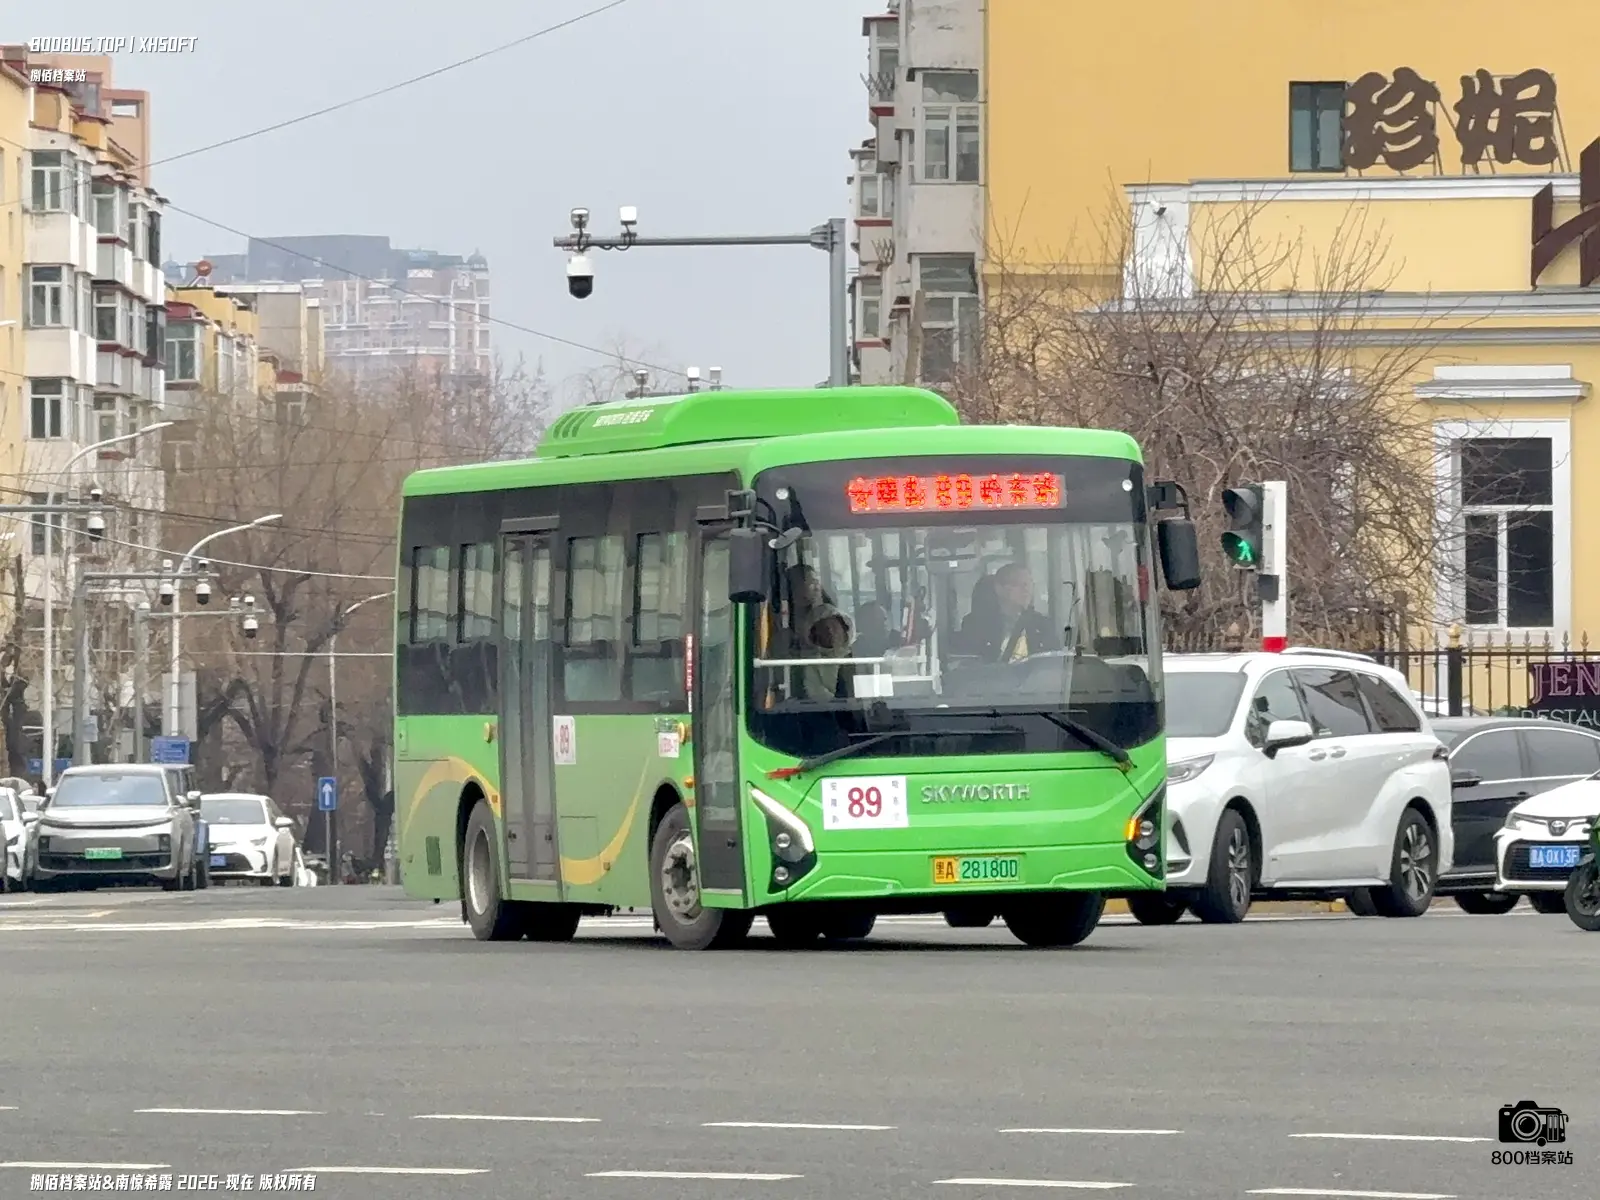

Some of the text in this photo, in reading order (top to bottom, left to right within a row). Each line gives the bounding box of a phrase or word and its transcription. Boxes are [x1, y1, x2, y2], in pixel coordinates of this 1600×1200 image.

[1532, 663, 1600, 705] JEN
[847, 786, 883, 818] 89
[920, 783, 1031, 805] SKYWORTH
